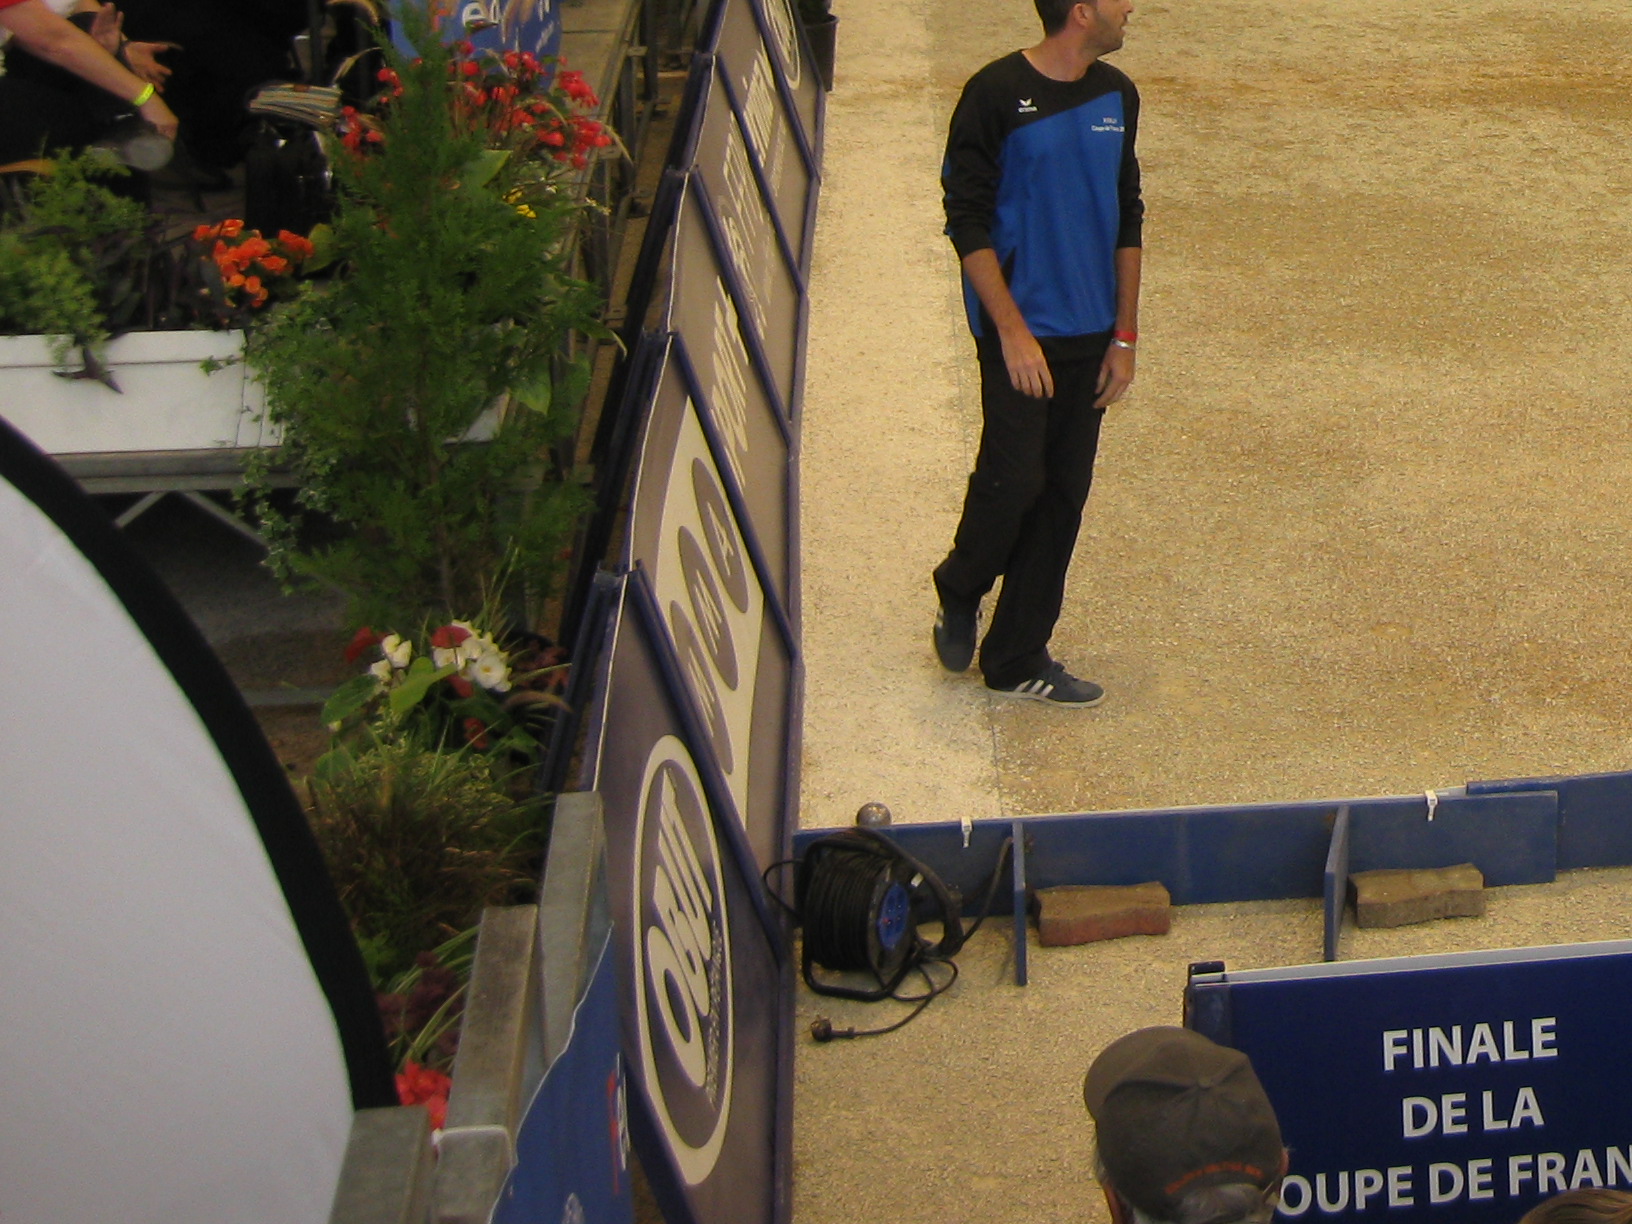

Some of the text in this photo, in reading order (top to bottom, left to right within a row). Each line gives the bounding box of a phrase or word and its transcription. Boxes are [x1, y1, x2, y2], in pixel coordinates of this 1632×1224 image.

[647, 767, 714, 1088] OBUT
[1383, 1017, 1558, 1071] FINALE
[1402, 1086, 1545, 1138] DE LA
[1276, 1166, 1415, 1216] OUPE
[1428, 1158, 1494, 1205] DE
